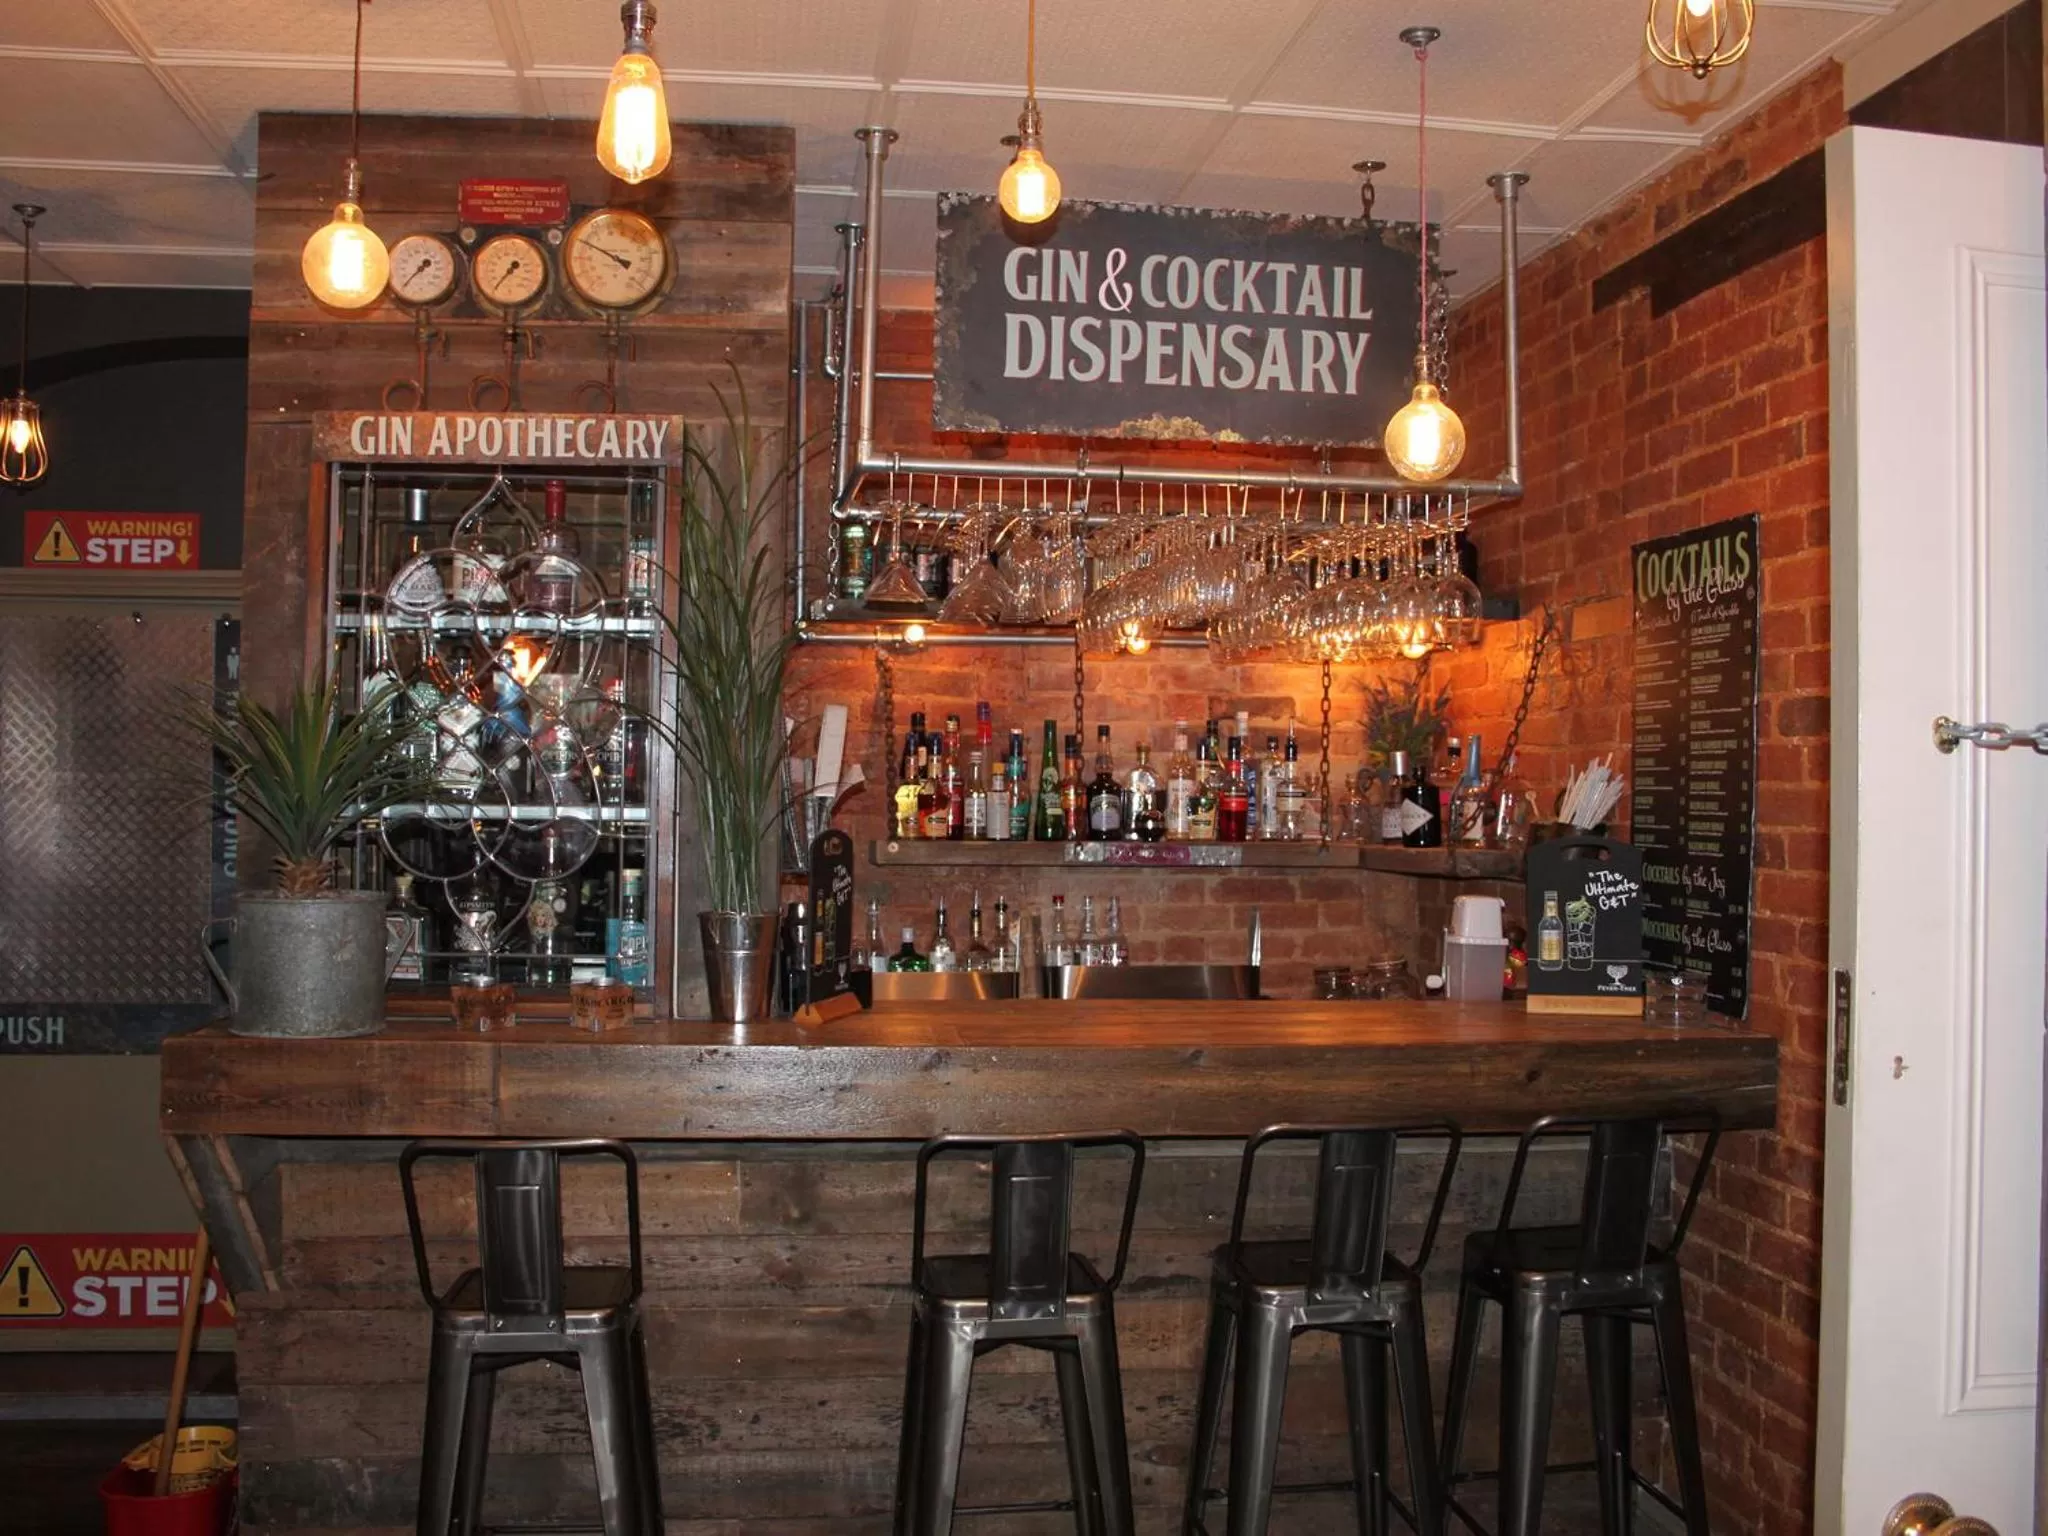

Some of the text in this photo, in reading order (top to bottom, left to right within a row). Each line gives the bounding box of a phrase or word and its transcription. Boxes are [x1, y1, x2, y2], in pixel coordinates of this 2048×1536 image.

[1003, 246, 1374, 320] GIN & COCKTAIL
[1003, 312, 1371, 396] DISPENSARY
[350, 416, 669, 459] GIN APOTHECARY
[86, 520, 193, 537] WARNING!
[86, 537, 175, 563] STEP
[1637, 531, 1750, 604] COCKTAILS
[1666, 565, 1745, 623] by the Glass
[1585, 879, 1639, 896] Ultimate
[1642, 863, 1680, 885] COCKTAILS
